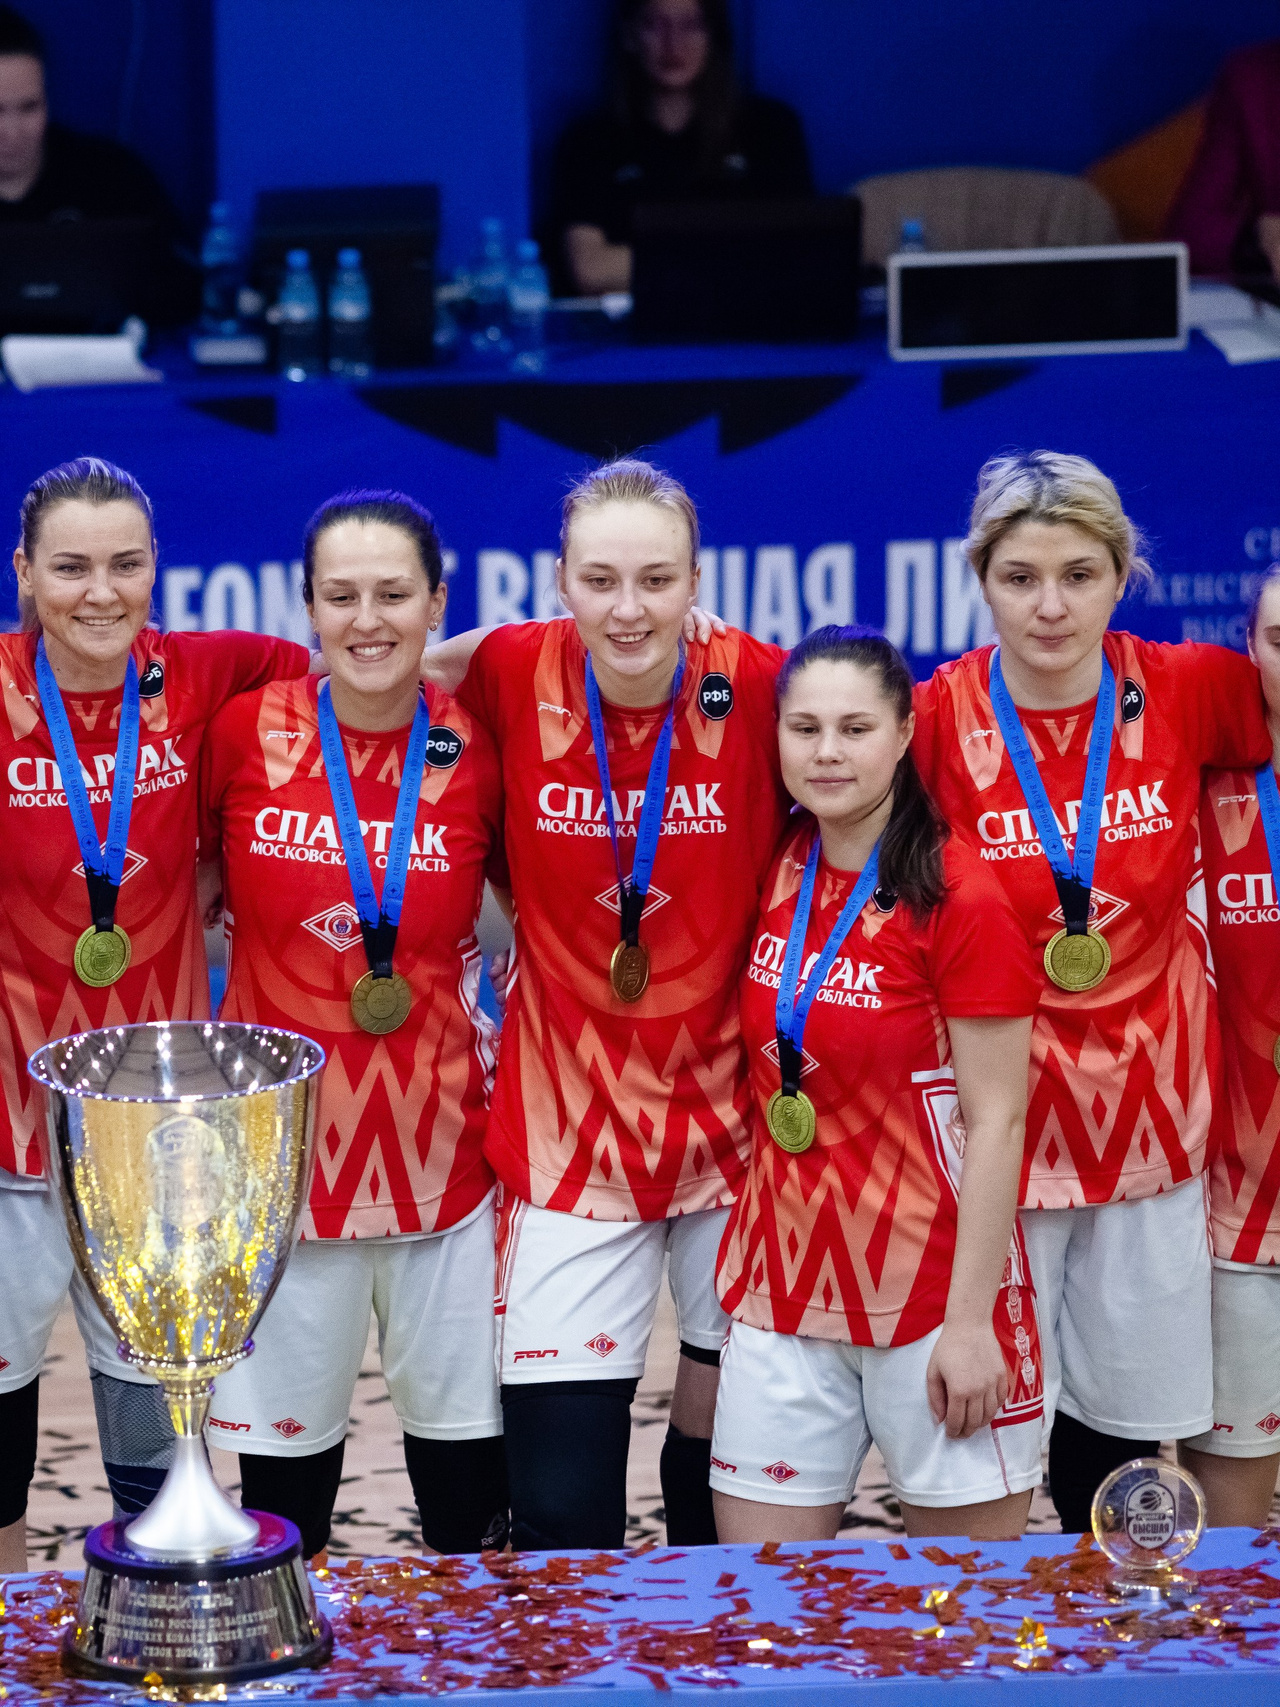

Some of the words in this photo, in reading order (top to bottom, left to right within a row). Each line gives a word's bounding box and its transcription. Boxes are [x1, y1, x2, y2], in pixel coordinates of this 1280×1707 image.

[702, 689, 730, 704] РФБ
[7, 734, 187, 791] СПРАК
[426, 739, 459, 754] РФБ
[8, 788, 112, 808] МОСКОКА
[132, 769, 188, 798] ОБЛАСТЬ
[538, 782, 725, 822] СПАРАК
[536, 817, 639, 838] МОСКОВКА
[658, 819, 727, 836] ОБЛАСТЬ
[980, 837, 1075, 861] МОСКОК
[1104, 816, 1173, 843] ОБЛАСТЬ
[249, 840, 348, 866] МОСКОВСК
[375, 855, 450, 873] ОАСТЬ
[753, 931, 885, 993] СПРТАК
[816, 988, 882, 1009] ОБЛАСТЬ
[1132, 1523, 1169, 1534] ВЫСШАЯ
